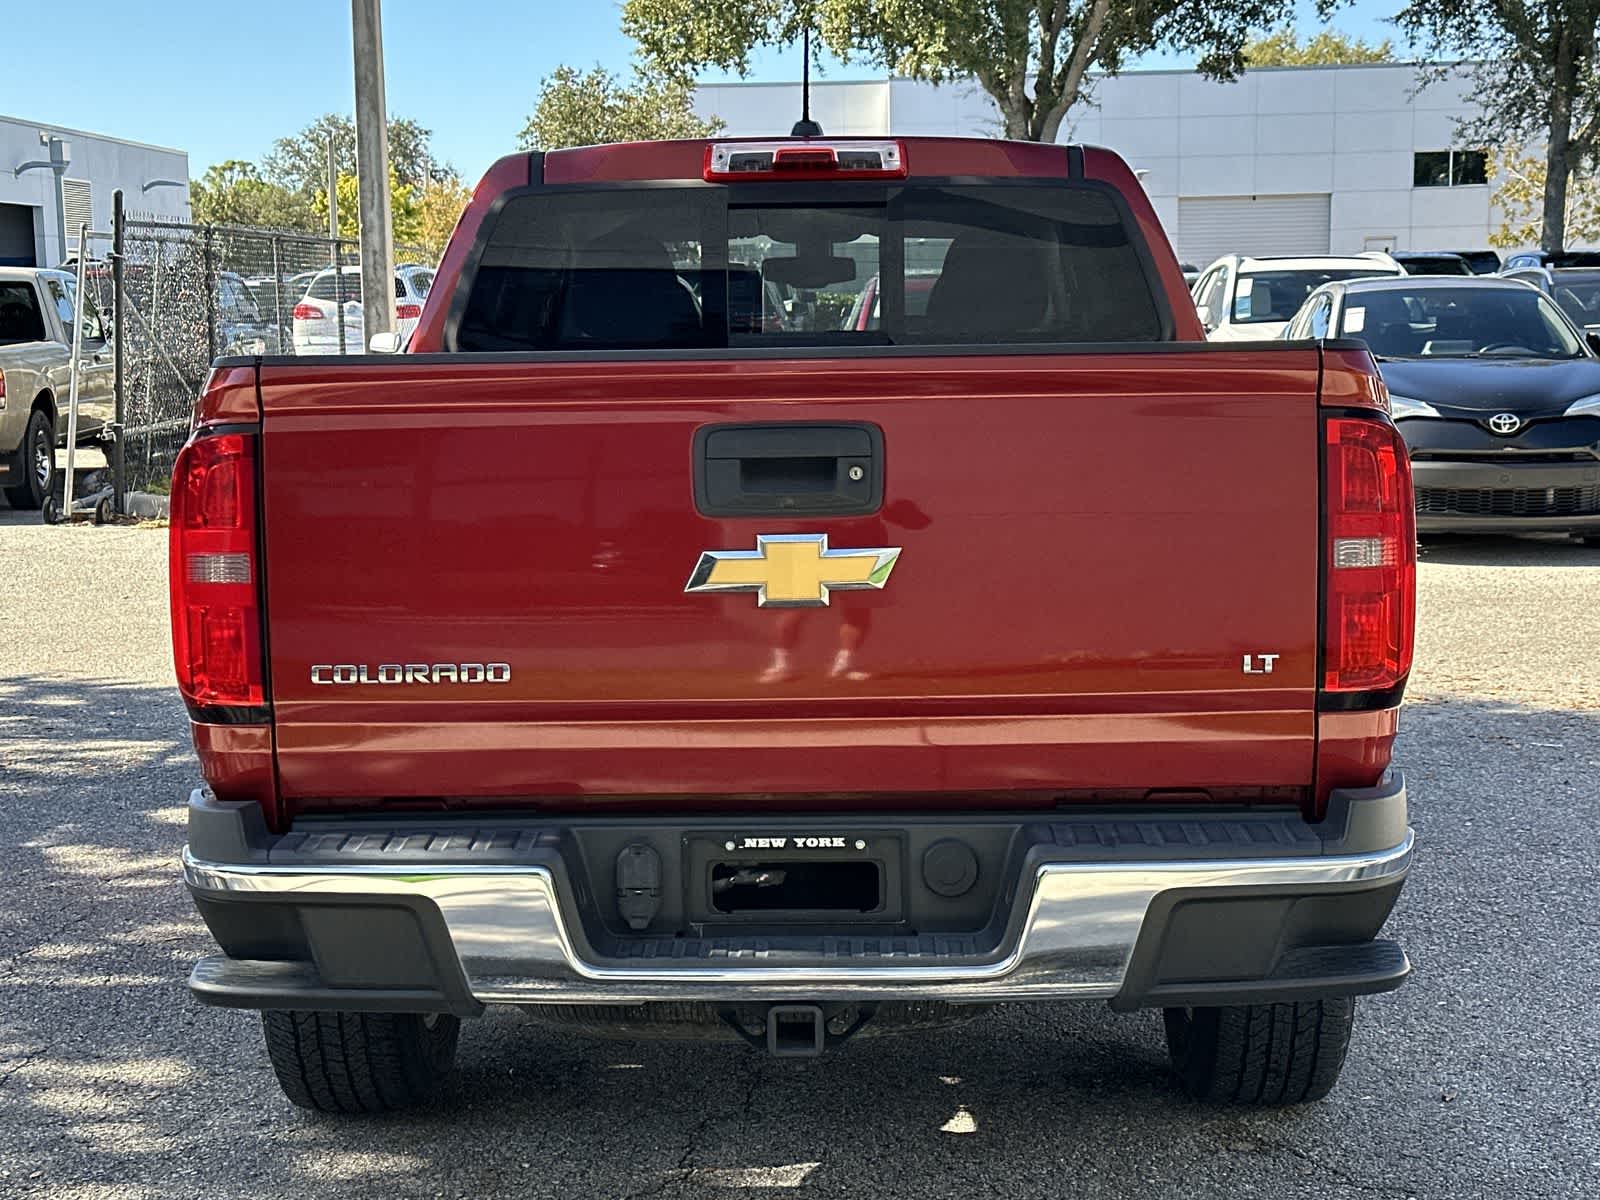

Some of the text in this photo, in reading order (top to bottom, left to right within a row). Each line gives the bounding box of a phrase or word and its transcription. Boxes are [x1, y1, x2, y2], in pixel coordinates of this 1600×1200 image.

[310, 663, 511, 685] COLORADO
[1243, 654, 1280, 674] LT
[743, 837, 846, 849] NEW YORK
